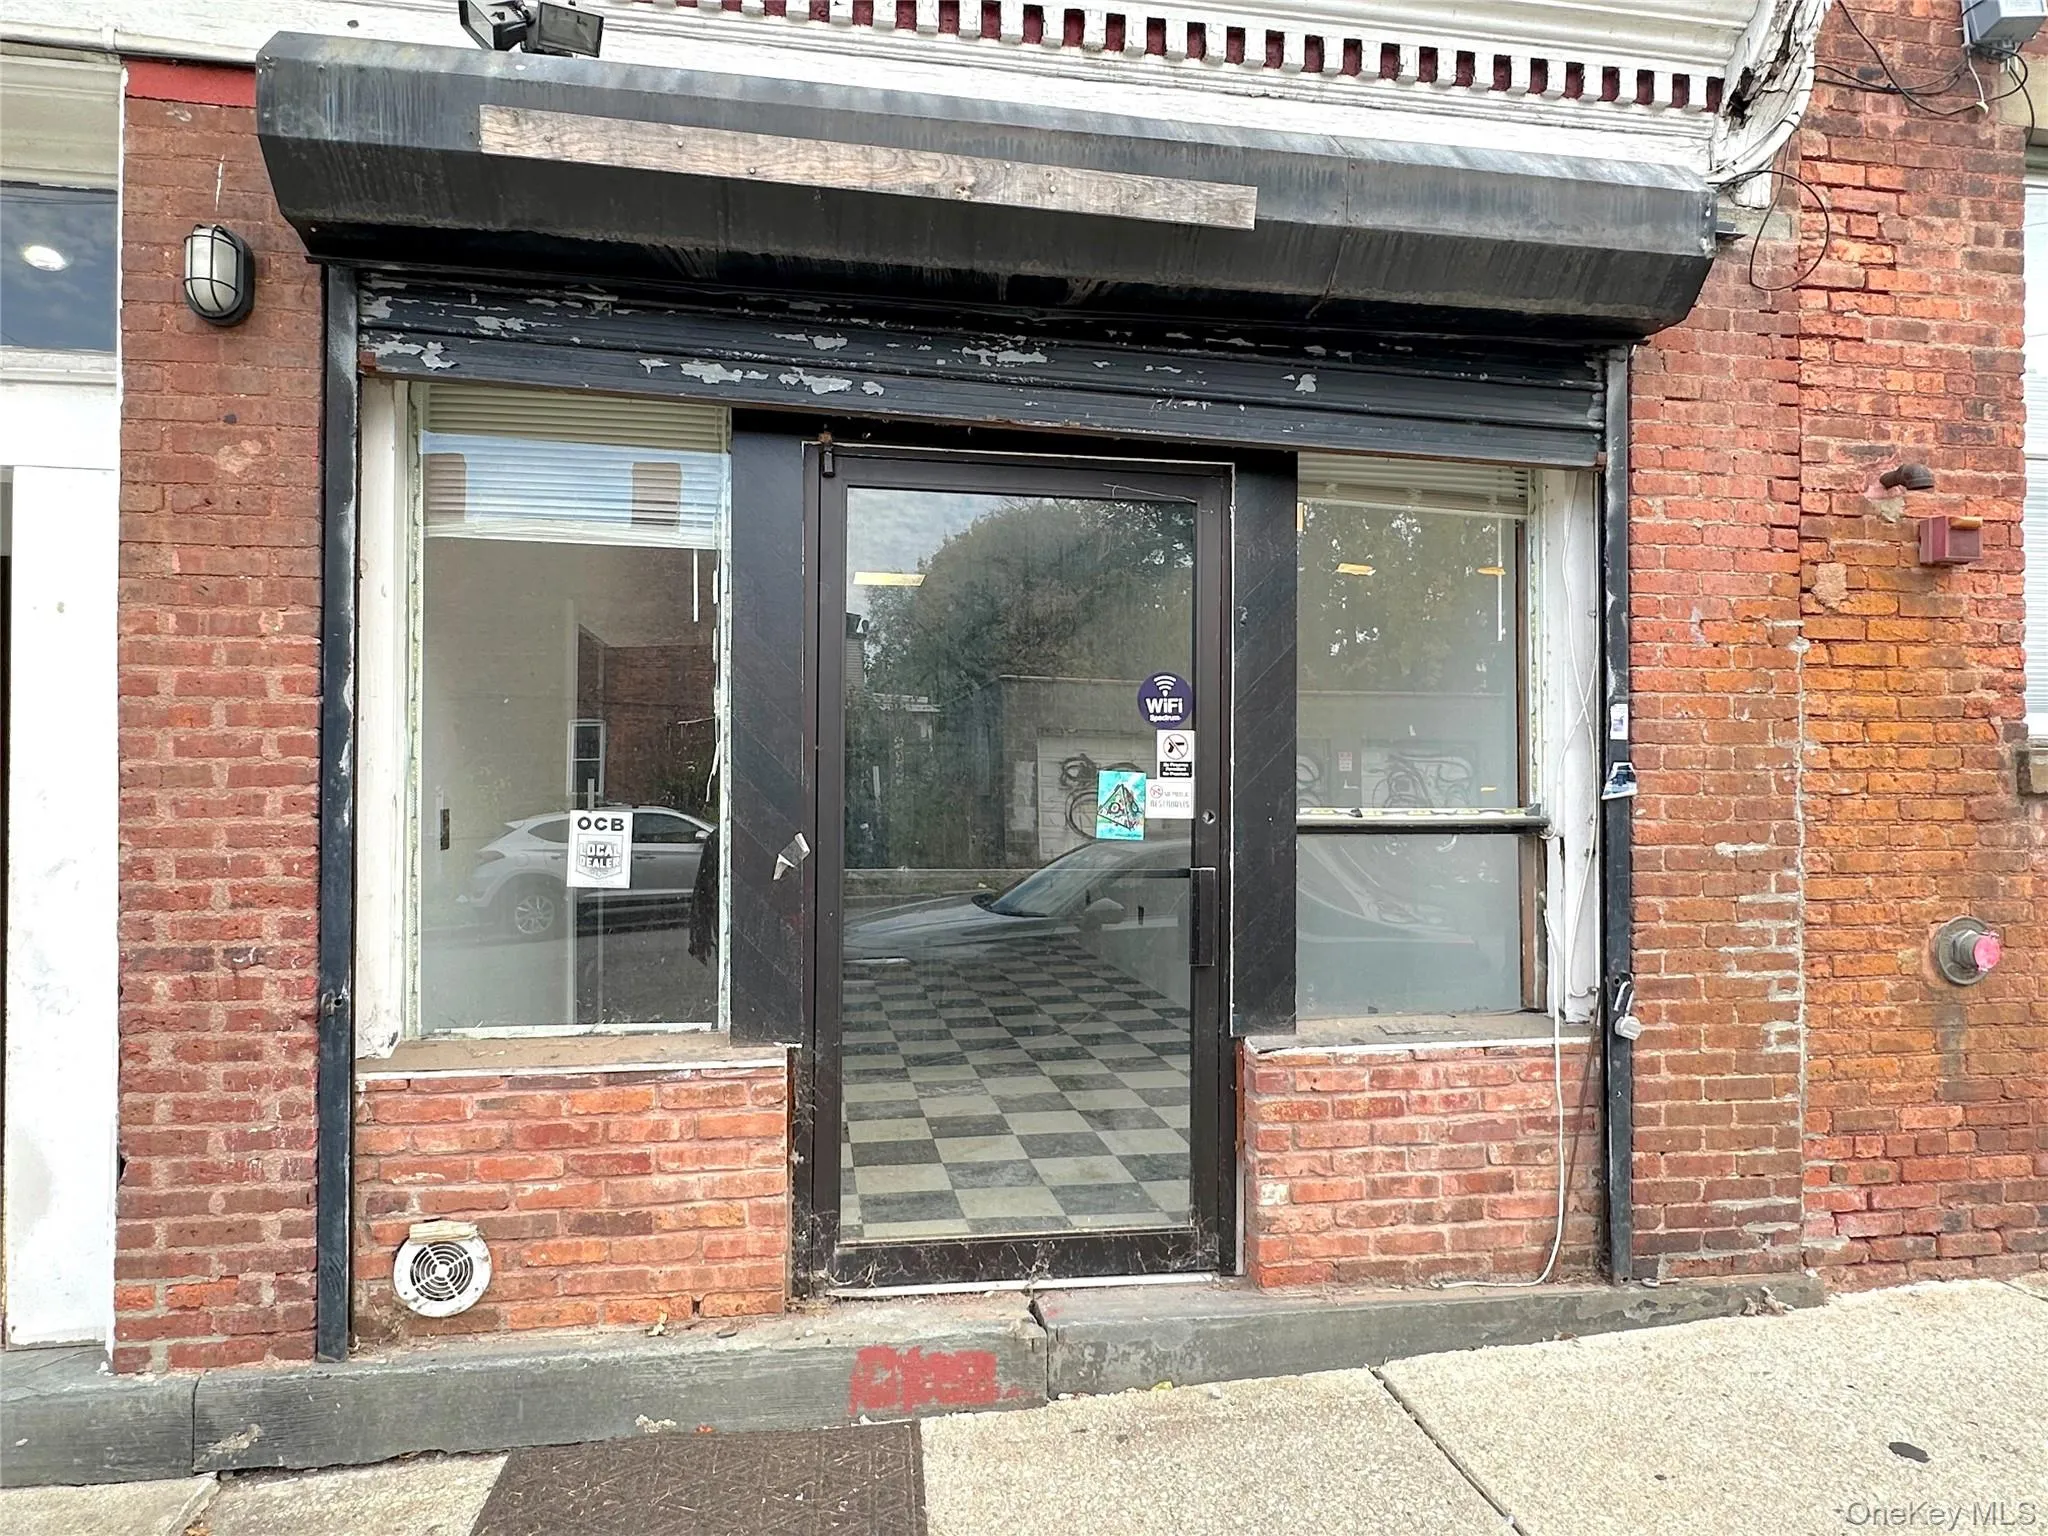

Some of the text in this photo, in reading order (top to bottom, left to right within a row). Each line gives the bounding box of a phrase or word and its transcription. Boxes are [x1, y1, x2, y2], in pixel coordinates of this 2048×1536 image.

[1145, 697, 1183, 714] WiFi
[577, 816, 624, 832] OCB
[579, 842, 621, 857] LOCAL
[579, 856, 621, 869] DEALER
